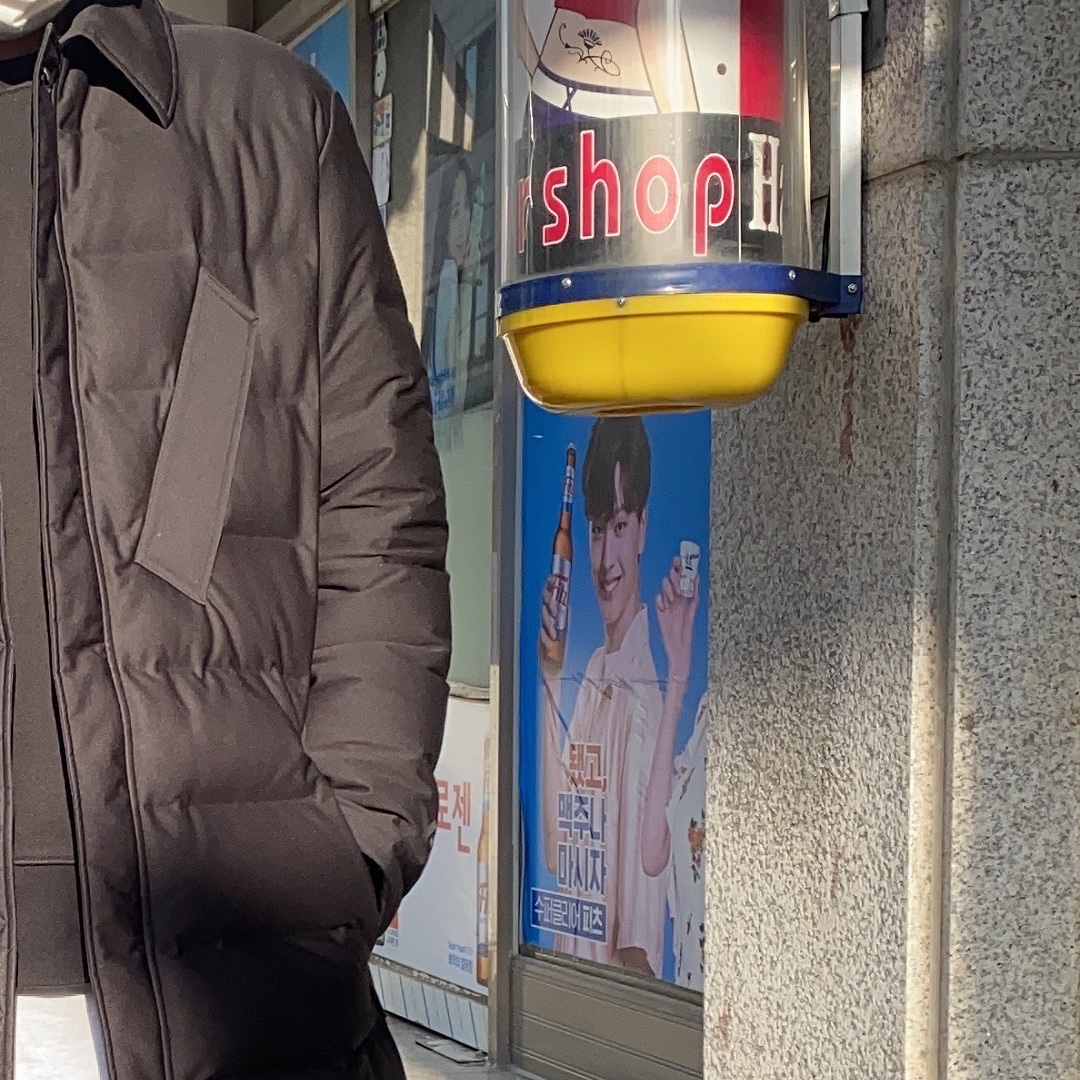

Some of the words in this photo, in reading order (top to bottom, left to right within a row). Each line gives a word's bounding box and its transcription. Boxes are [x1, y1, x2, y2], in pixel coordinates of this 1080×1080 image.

[542, 129, 735, 257] shop
[558, 793, 607, 843] 맥주나
[558, 844, 607, 896] 마시자
